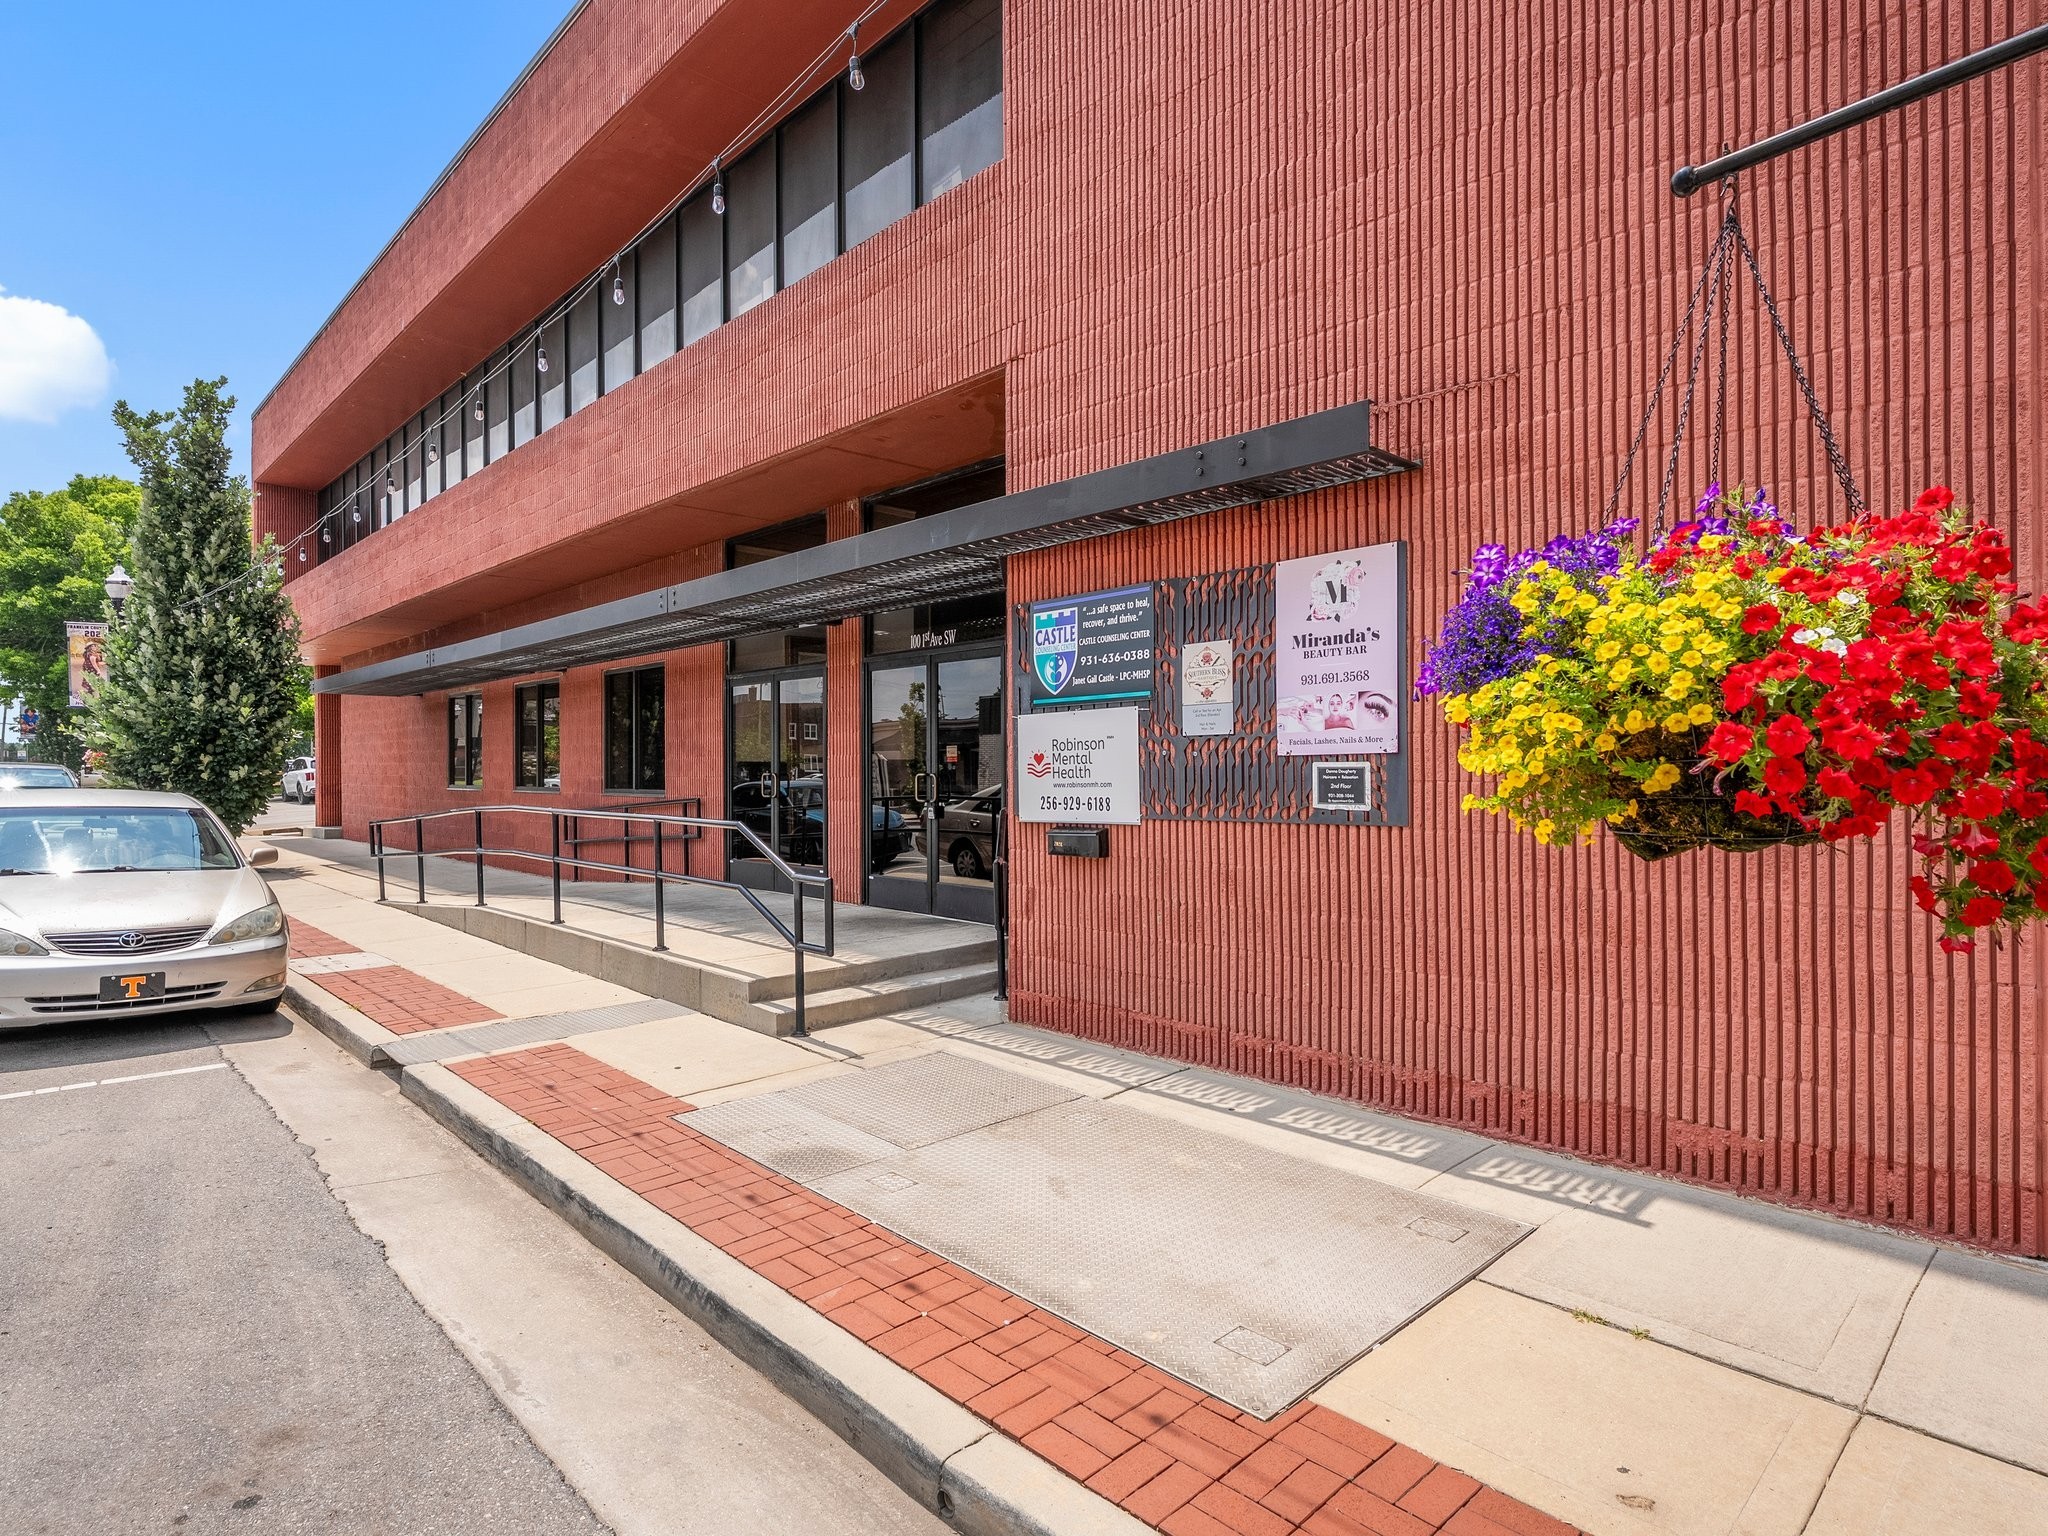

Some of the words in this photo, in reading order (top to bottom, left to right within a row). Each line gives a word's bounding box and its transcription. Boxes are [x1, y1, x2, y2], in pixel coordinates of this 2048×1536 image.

[1325, 579, 1348, 604] M
[1097, 603, 1108, 614] safe
[1109, 602, 1125, 614] space
[1127, 600, 1134, 609] to
[1135, 597, 1150, 608] heal,
[1082, 618, 1106, 629] recover,
[1107, 615, 1118, 625] and
[910, 633, 921, 649] 100
[922, 630, 930, 648] 1st
[929, 632, 943, 648] Ave
[943, 629, 957, 645] SW
[1035, 625, 1076, 646] CASTLE
[1079, 636, 1096, 646] CASTLE
[1096, 631, 1130, 643] COUNSELING
[1130, 629, 1150, 640] CENTER
[1061, 642, 1076, 650] CENTER
[1303, 647, 1343, 659] BEAUTY
[1345, 645, 1367, 656] BAR
[1080, 649, 1150, 666] 931-636-0388
[1072, 676, 1086, 686] Janet
[1086, 675, 1098, 684] Gail
[1098, 673, 1115, 683] Castle
[1119, 669, 1151, 681] LPC-MHSP
[1300, 670, 1370, 686] 931.691.3568
[1051, 738, 1105, 752] Robinson
[1289, 738, 1313, 746] Facials,
[1314, 737, 1339, 745] Lashes,
[1340, 736, 1357, 744] Nails
[1365, 735, 1384, 743] More
[1052, 750, 1093, 765] Mental
[1052, 765, 1091, 779] Health
[1053, 781, 1113, 789] www.robinsonmh.com
[1040, 795, 1111, 812] 256-929-6188
[120, 975, 146, 998] T
